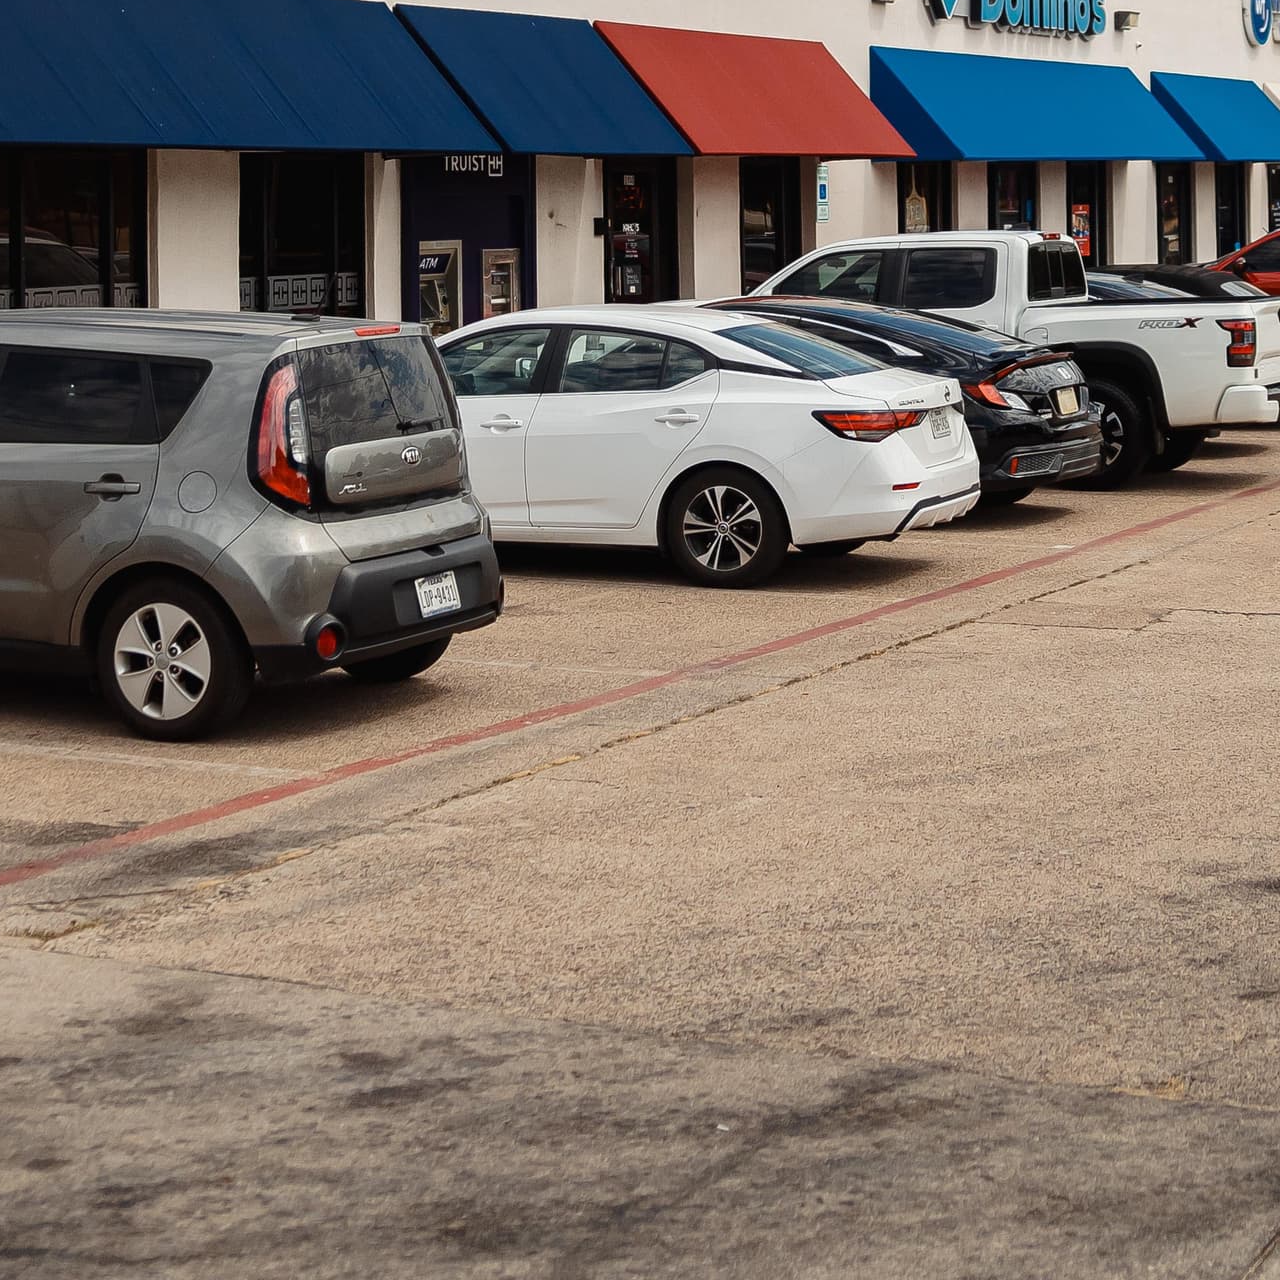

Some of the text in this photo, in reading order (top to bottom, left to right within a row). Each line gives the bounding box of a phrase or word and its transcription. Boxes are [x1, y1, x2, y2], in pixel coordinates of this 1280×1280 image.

[444, 154, 486, 172] TRUIST
[419, 257, 439, 269] ATM
[406, 450, 419, 463] KIA
